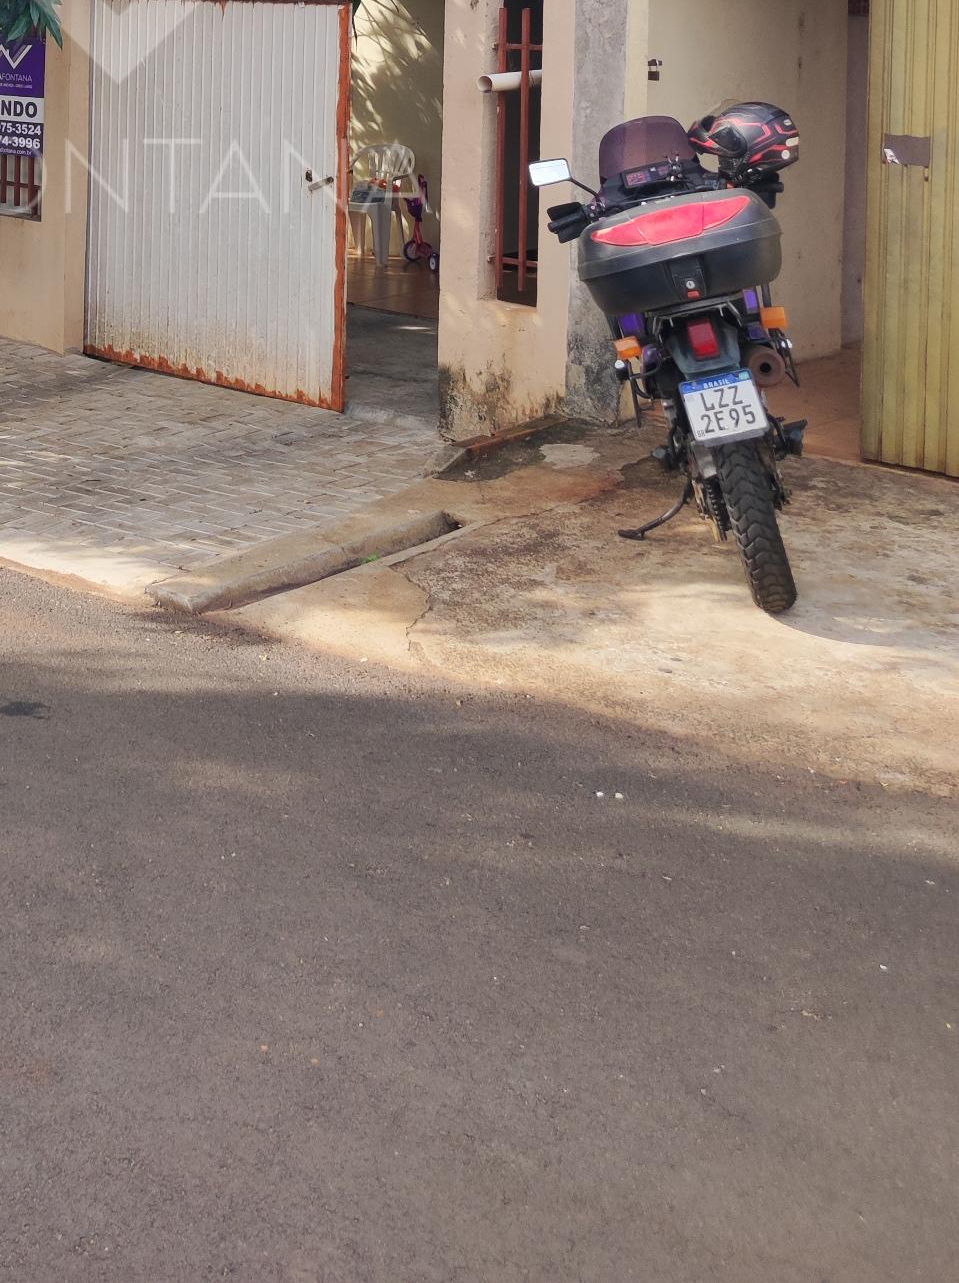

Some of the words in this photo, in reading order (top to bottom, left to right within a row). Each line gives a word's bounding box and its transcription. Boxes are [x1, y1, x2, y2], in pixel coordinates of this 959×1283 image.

[703, 379, 730, 389] BRASIL
[700, 385, 743, 411] LZZ
[700, 404, 756, 433] 2E95
